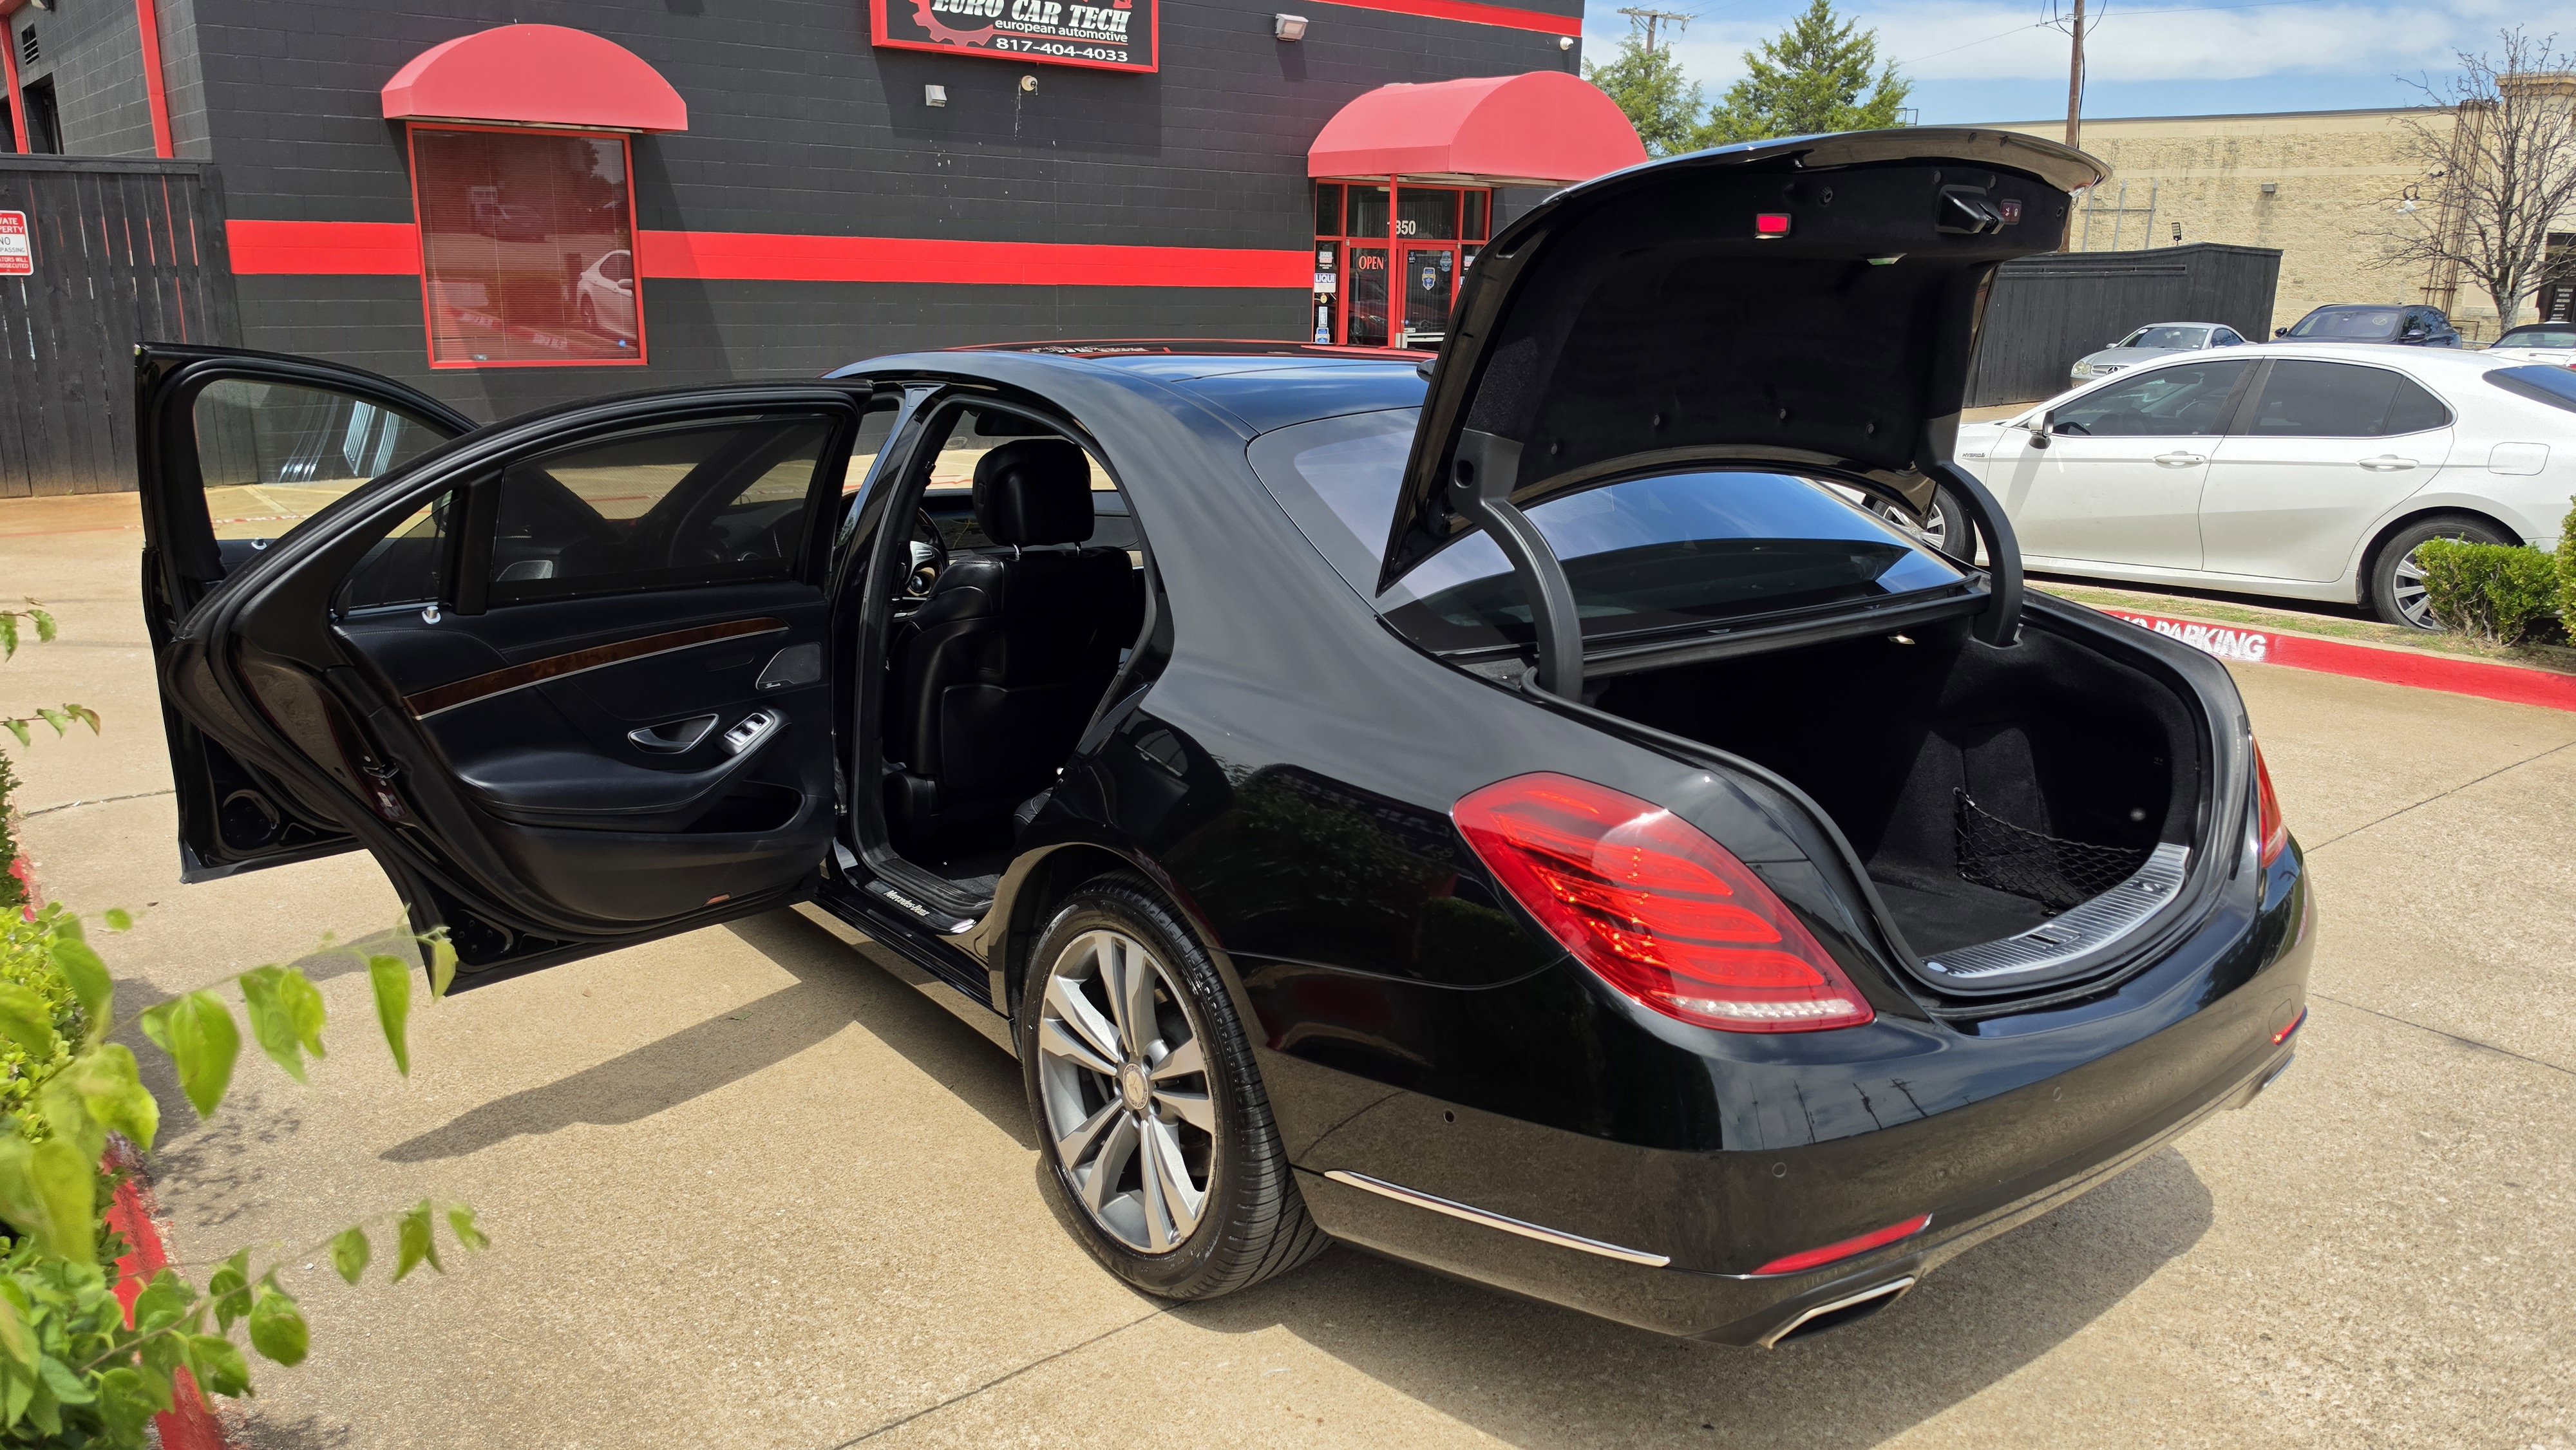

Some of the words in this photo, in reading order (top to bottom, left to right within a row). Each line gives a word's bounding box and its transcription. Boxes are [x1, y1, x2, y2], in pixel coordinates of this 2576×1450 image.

[1011, 0, 1062, 24] CAR
[1068, 5, 1132, 33] TECH
[995, 19, 1056, 35] european
[1058, 27, 1128, 42] automotive
[996, 38, 1128, 62] 817-404-4033
[1387, 220, 1416, 234] 850
[1358, 256, 1384, 270] OPEN
